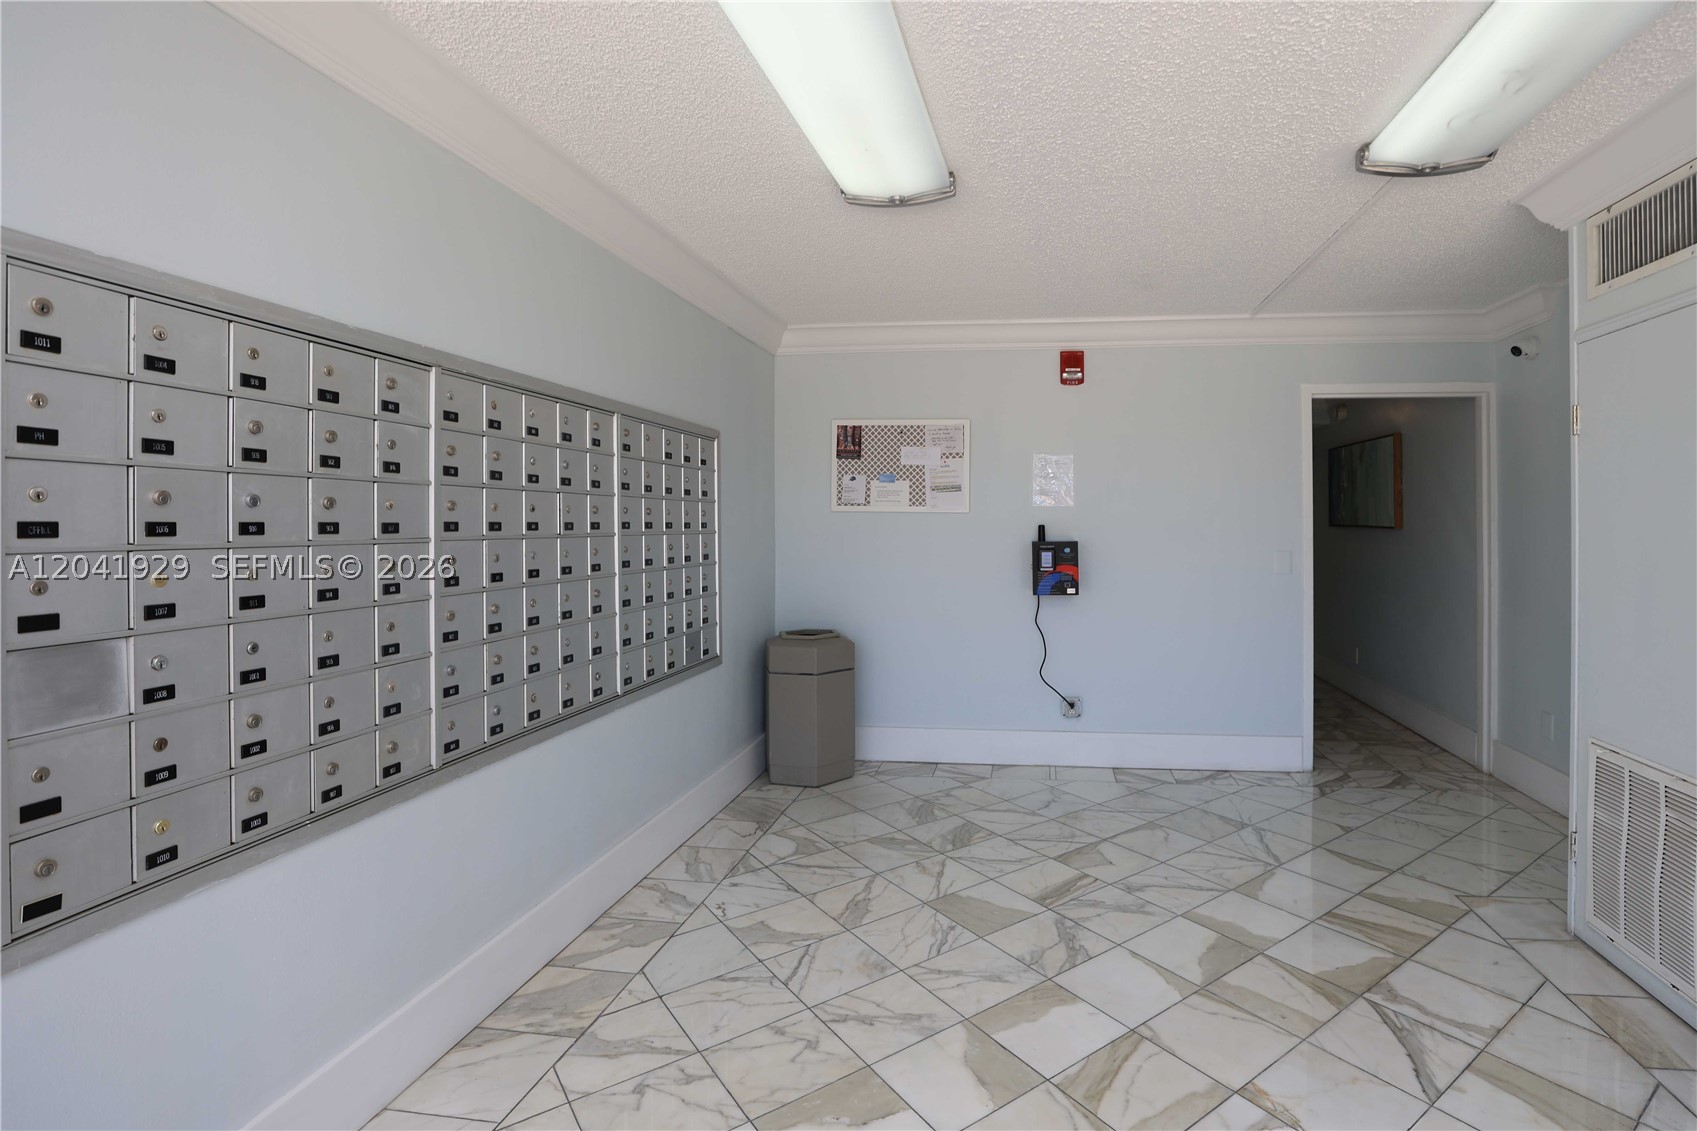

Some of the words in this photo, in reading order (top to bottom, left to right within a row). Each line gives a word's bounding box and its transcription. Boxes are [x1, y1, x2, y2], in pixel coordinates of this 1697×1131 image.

[34, 337, 51, 348] 1011
[34, 432, 44, 440] PH
[156, 525, 169, 533] 1006
[155, 607, 168, 616] 1007
[154, 689, 167, 699] 1008
[249, 745, 261, 754] 1002
[156, 770, 169, 781] 1009
[250, 818, 261, 828] 1003
[156, 852, 170, 864] 1010
